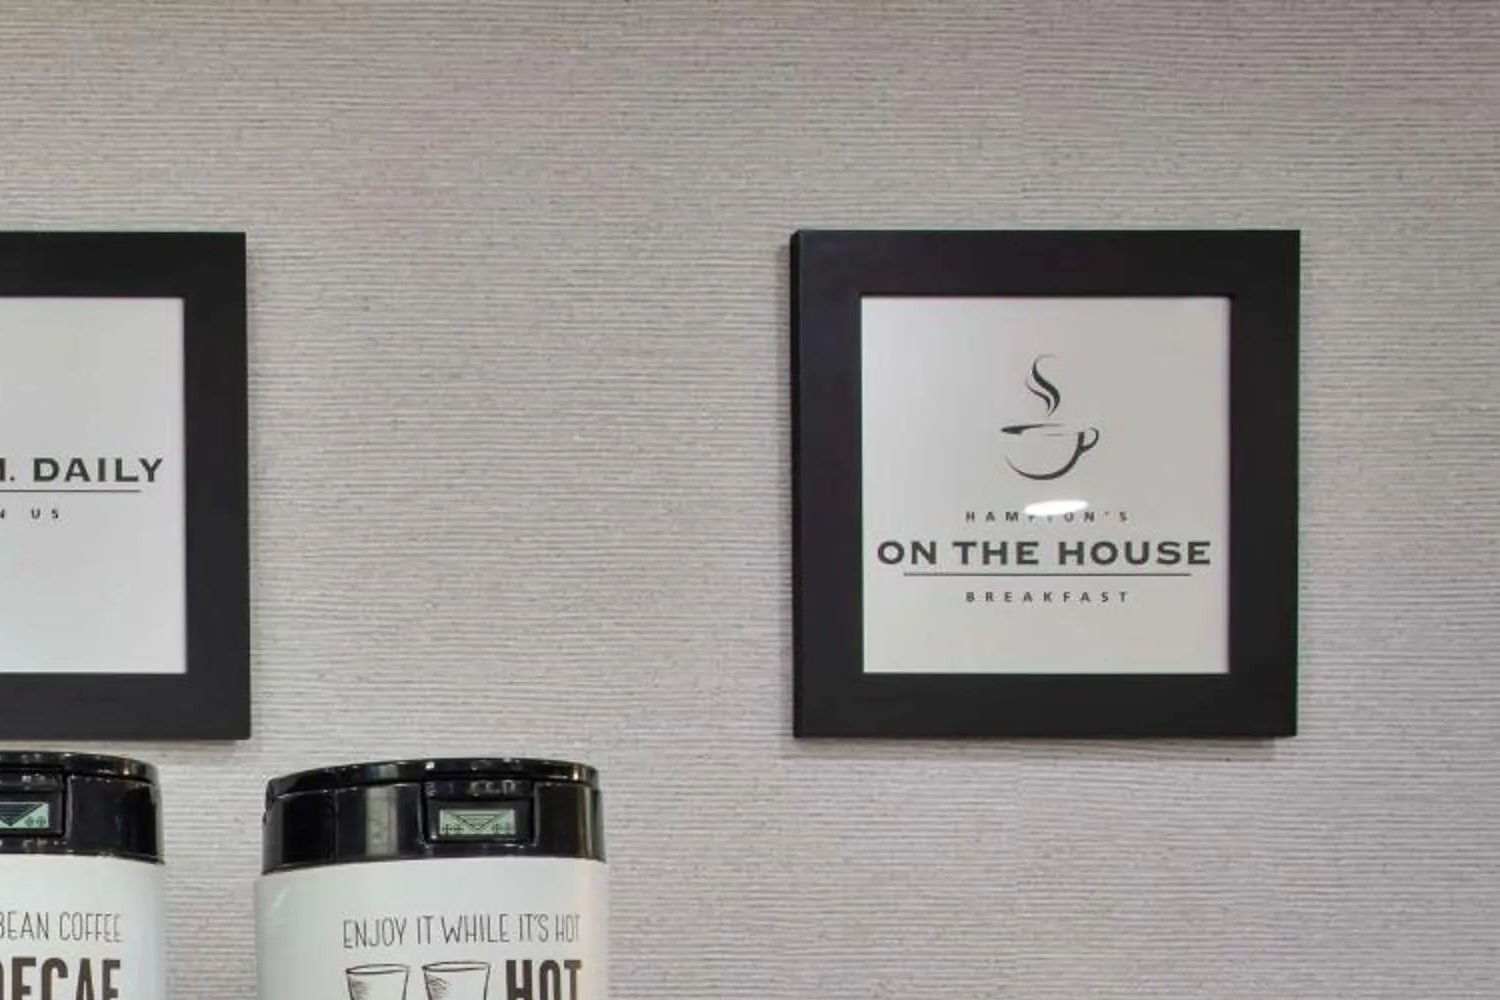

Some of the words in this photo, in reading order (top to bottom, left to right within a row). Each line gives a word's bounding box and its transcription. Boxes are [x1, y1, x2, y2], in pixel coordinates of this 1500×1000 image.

[33, 457, 164, 483] DAILY
[31, 508, 59, 519] US
[877, 540, 937, 566] ON
[951, 540, 1040, 566] THE
[1057, 540, 1212, 566] HOUSE
[965, 591, 1128, 603] BREAKFAST
[59, 911, 122, 944] COFFEE
[343, 918, 408, 950] ENJOY
[416, 915, 440, 946] IT
[441, 913, 511, 946] WHILE
[518, 912, 550, 944] IT'S
[555, 912, 581, 943] HOT
